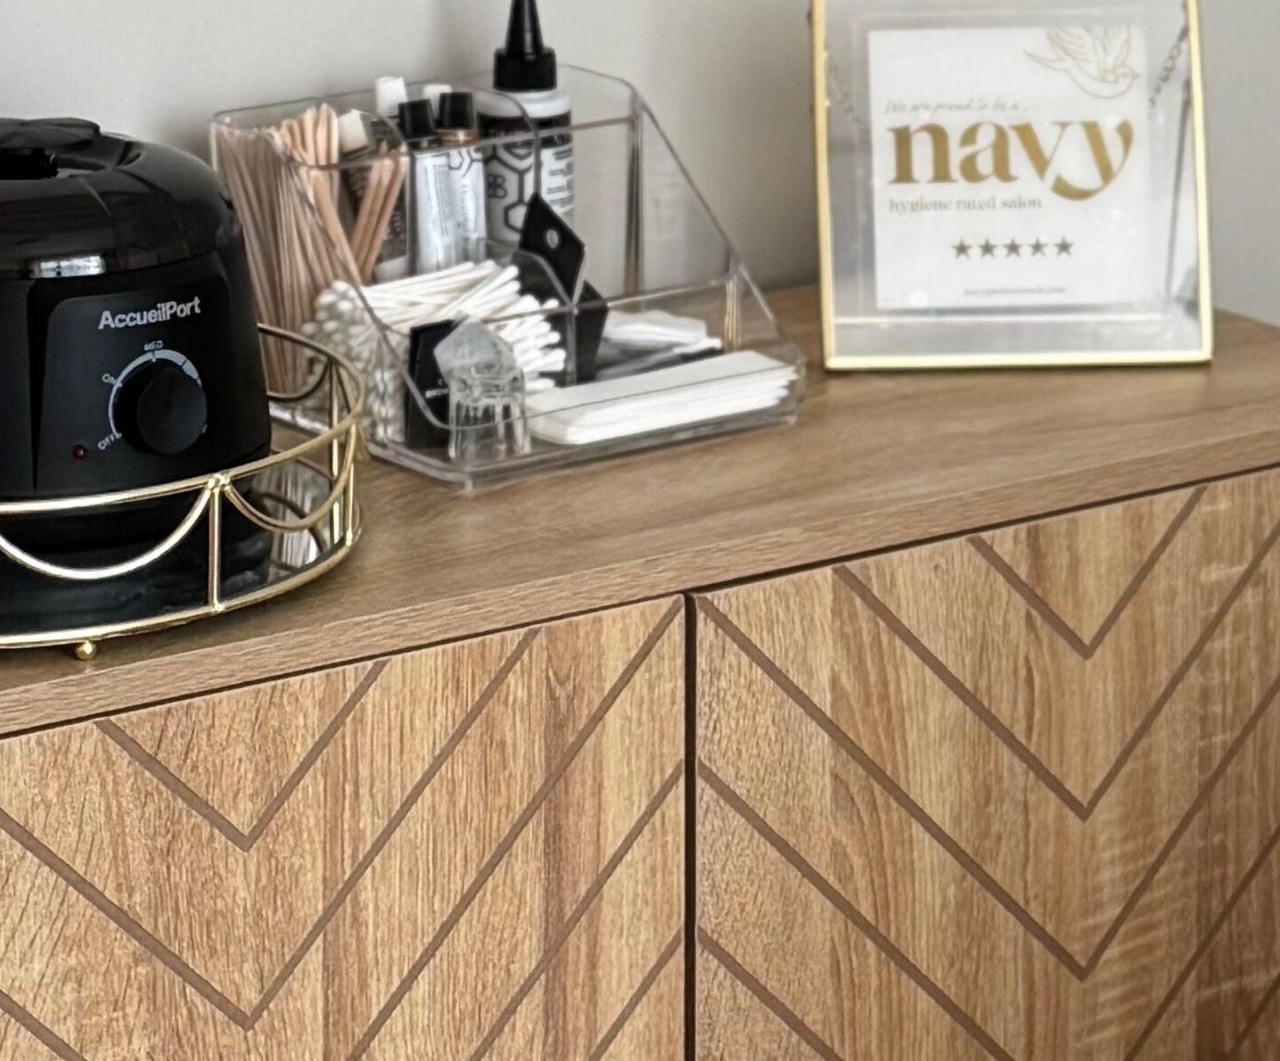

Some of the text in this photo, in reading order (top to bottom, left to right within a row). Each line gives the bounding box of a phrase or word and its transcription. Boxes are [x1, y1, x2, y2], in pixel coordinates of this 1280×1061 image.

[886, 119, 1134, 202] navy
[888, 193, 1043, 215] hygiene rated salon
[98, 295, 201, 330] AccueilPort
